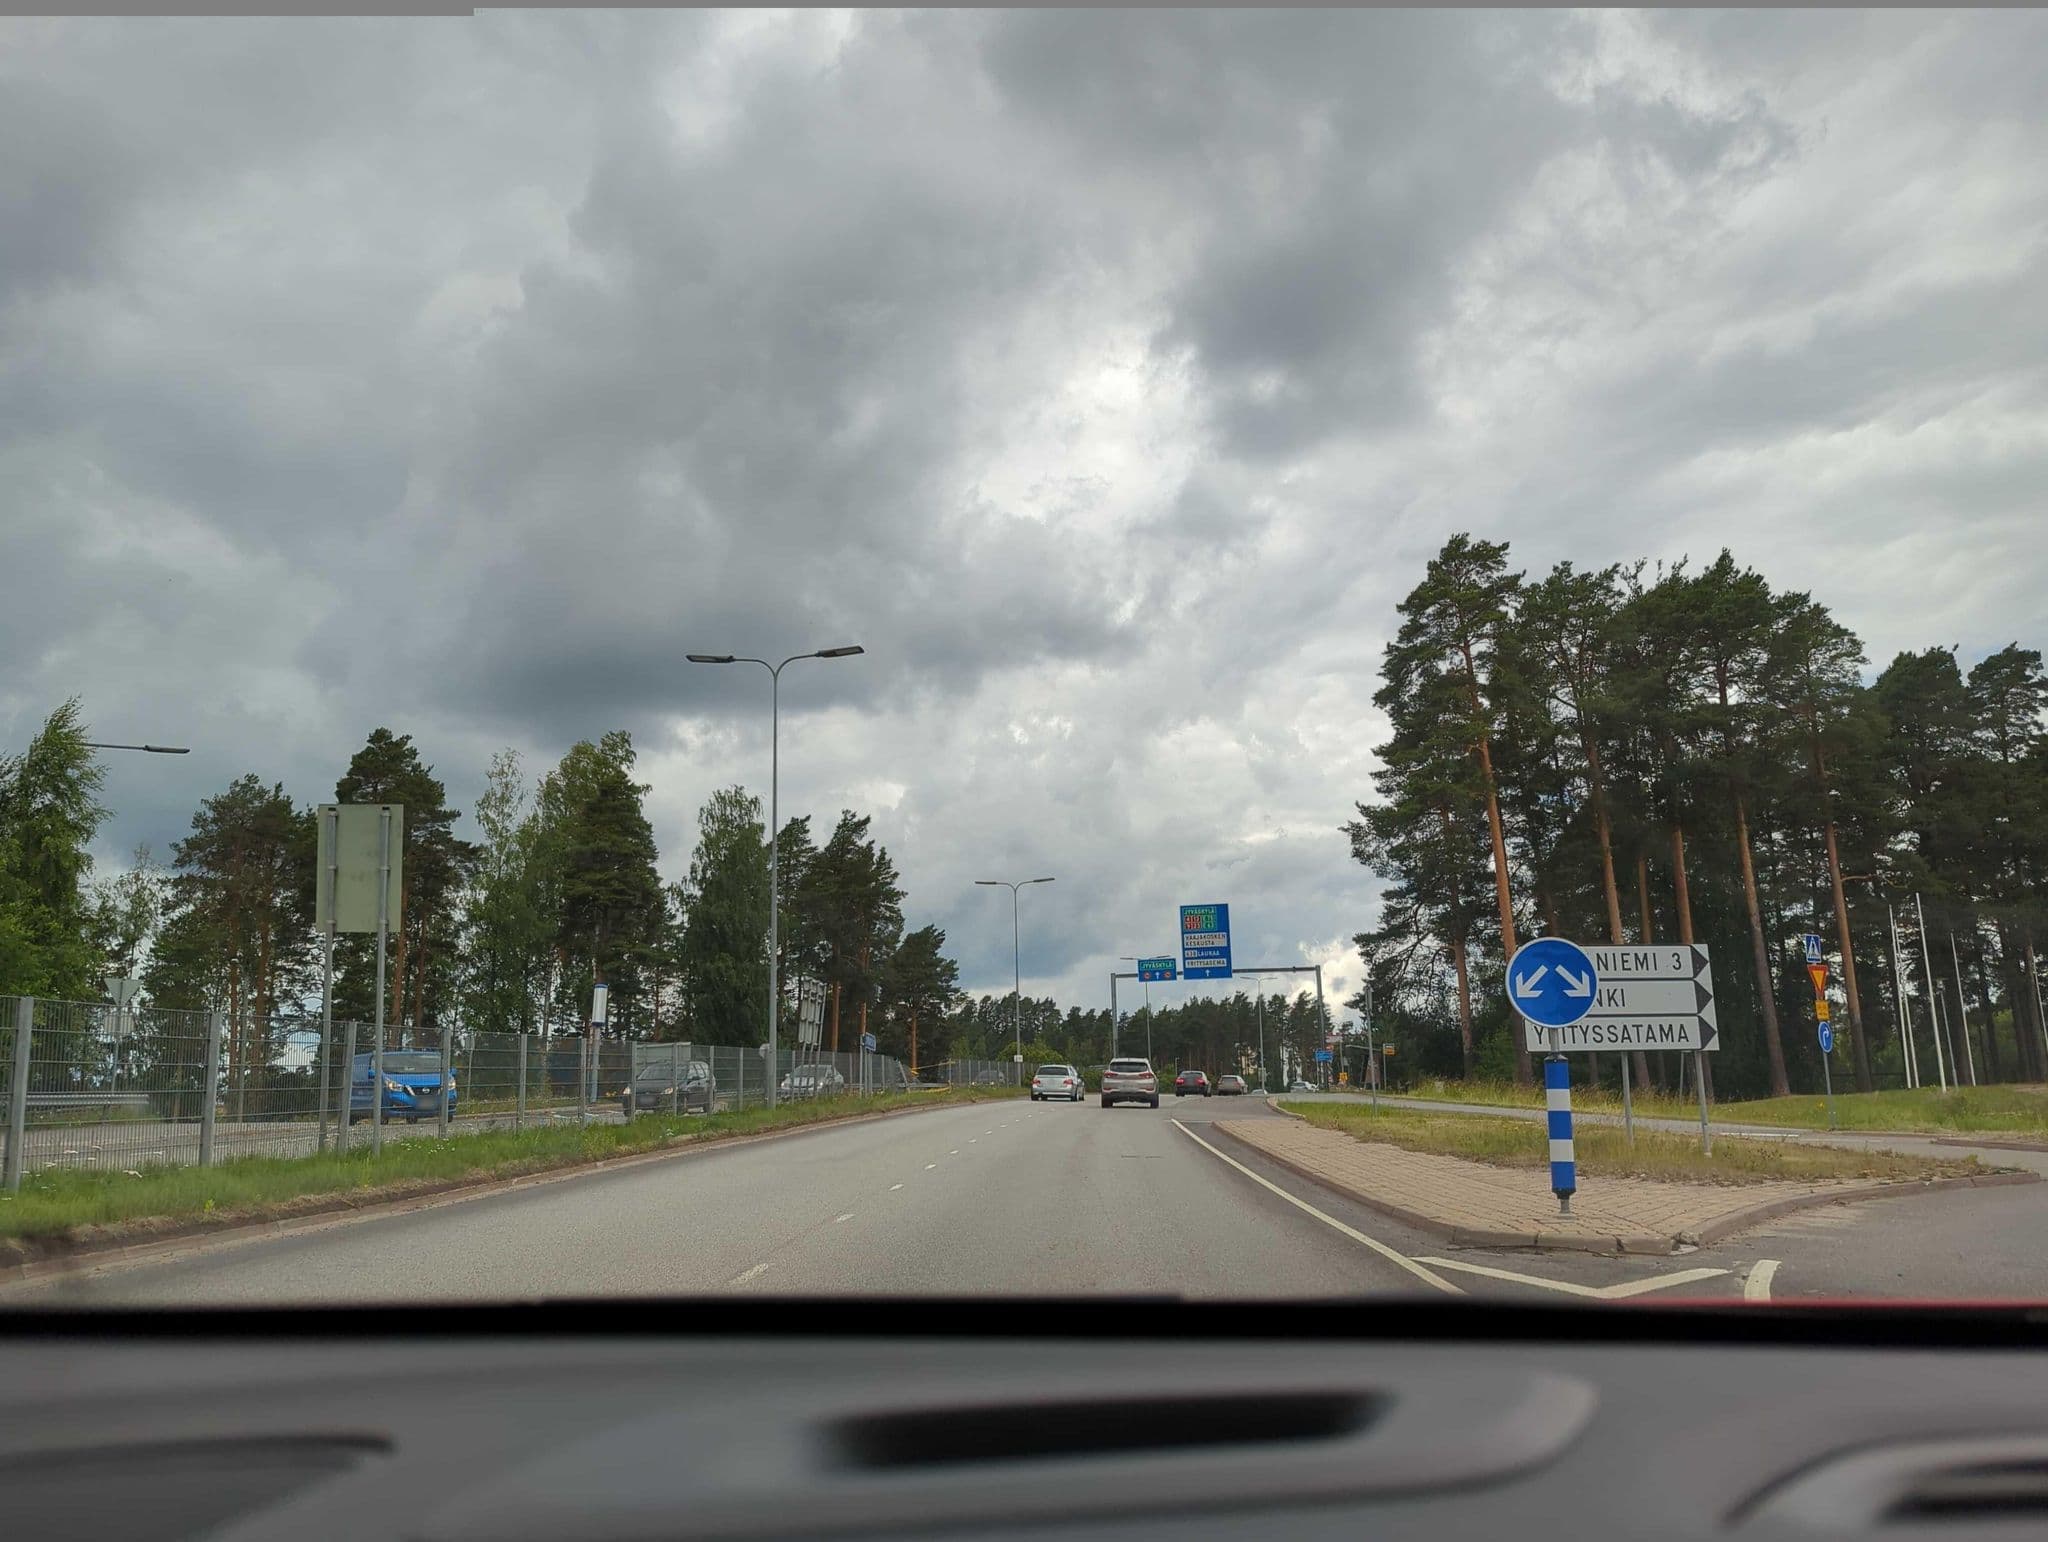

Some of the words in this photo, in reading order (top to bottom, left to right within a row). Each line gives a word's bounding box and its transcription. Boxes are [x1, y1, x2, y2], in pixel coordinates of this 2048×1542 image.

[1596, 952, 1658, 971] NIEMI
[1672, 952, 1682, 970] 3
[1533, 1024, 1690, 1044] YITYSSATAMA
